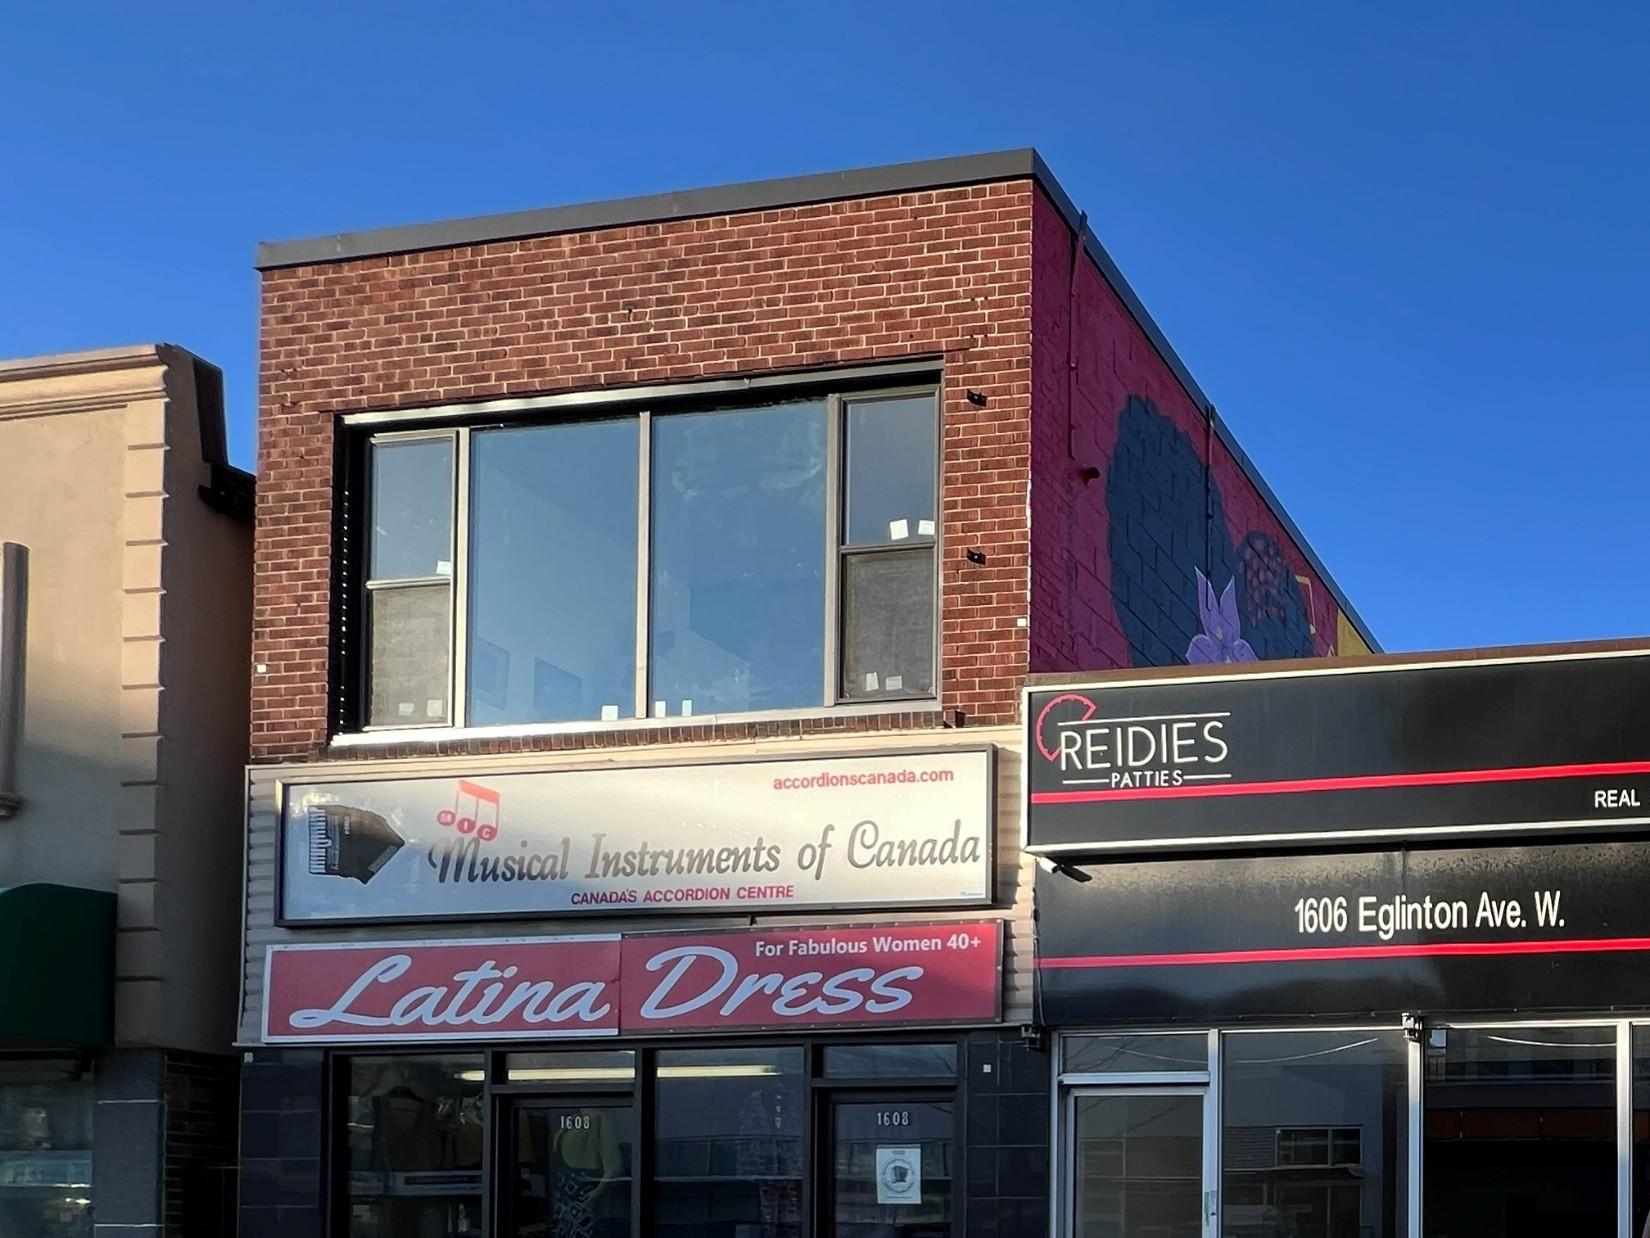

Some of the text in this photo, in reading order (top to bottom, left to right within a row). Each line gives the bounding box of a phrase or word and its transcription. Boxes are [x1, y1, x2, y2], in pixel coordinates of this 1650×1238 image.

[1060, 720, 1229, 771] REIDIES
[772, 768, 954, 791] accordionscanada.com
[1110, 769, 1183, 789] PATTIES
[1594, 788, 1641, 809] REAL
[427, 818, 981, 884] Musical Instruments of Canada
[644, 886, 731, 903] ACCORDION
[736, 884, 795, 900] CENTRE
[1293, 889, 1565, 941] 1606 Eglinton Ave. W.
[754, 933, 982, 957] For Fabulous Women 40+
[288, 953, 612, 1030] Latina
[639, 945, 925, 1020] Dress
[560, 1115, 591, 1130] 1608
[876, 1111, 910, 1127] 1608
